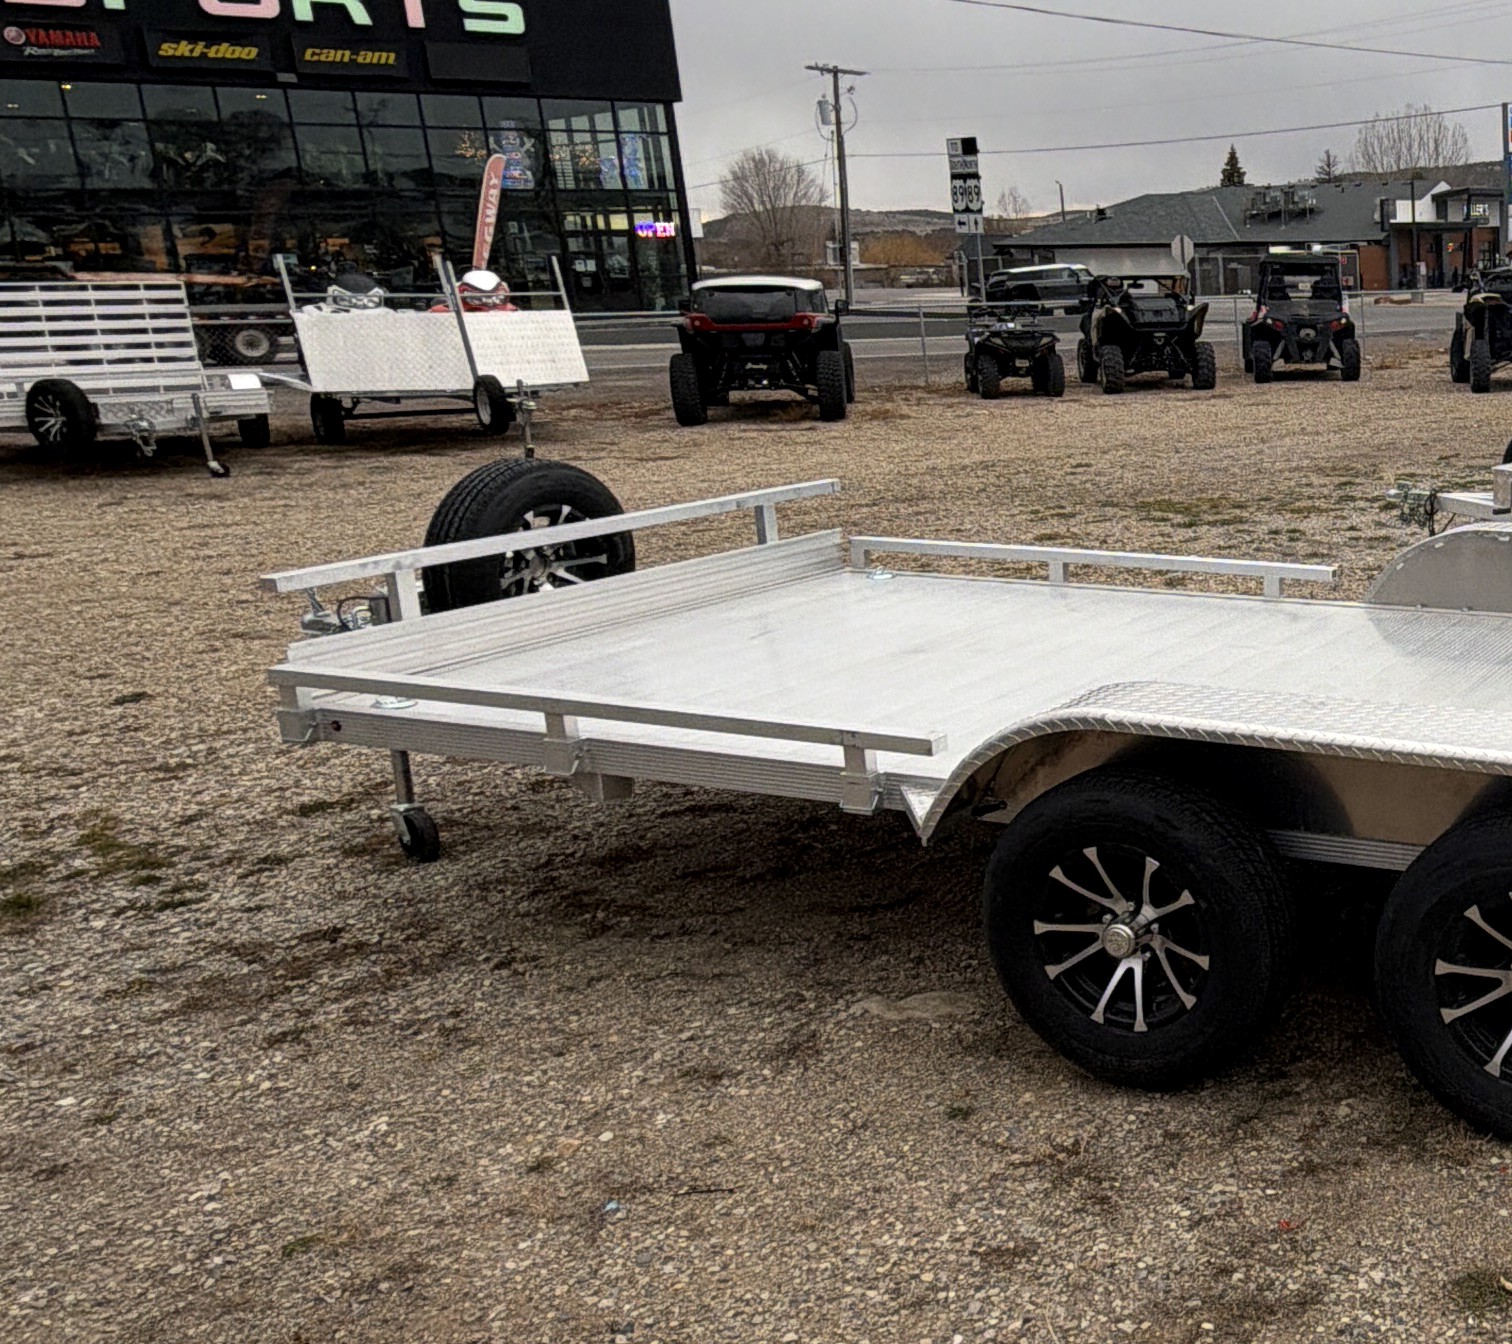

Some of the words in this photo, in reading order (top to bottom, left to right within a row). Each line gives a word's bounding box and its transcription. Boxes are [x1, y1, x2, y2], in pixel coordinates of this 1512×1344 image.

[25, 28, 100, 47] YAMAHA
[158, 40, 259, 60] ski-doo
[304, 47, 396, 65] can-am
[952, 185, 965, 203] 89
[967, 185, 981, 203] 89
[635, 221, 676, 239] OPEN
